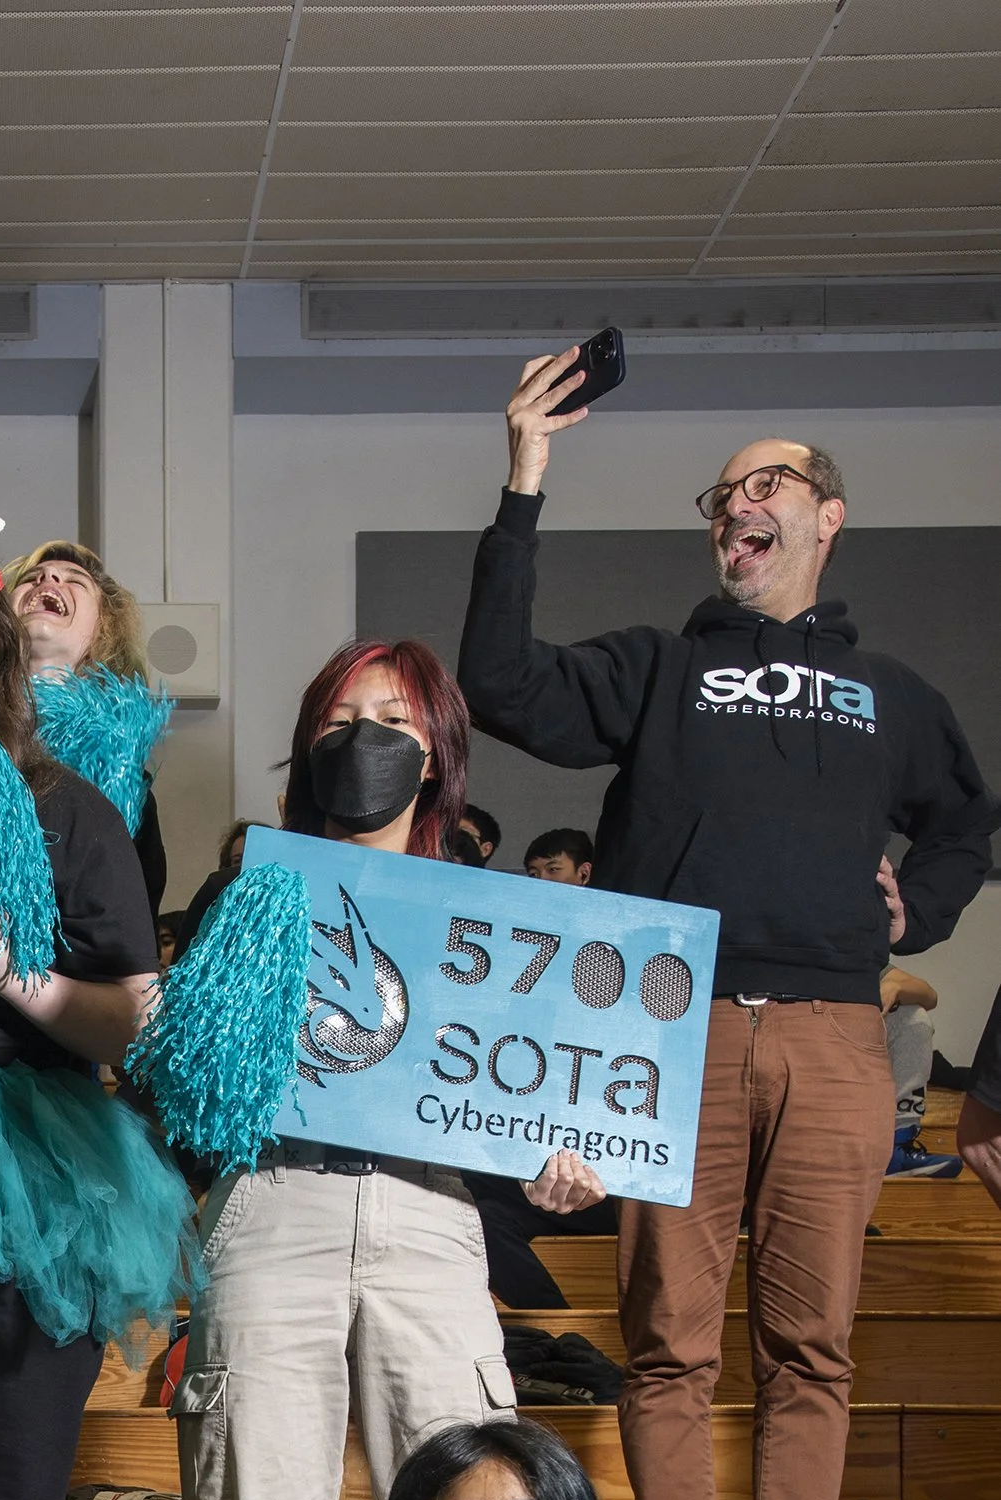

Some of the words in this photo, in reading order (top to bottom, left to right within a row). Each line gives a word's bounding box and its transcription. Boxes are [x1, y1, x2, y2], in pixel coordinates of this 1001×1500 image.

[696, 701, 876, 734] CYBERDRAGONS
[699, 662, 876, 721] SOTa
[438, 916, 694, 1022] 5700
[429, 1023, 660, 1120] SOTa
[415, 1094, 670, 1167] Cyberdragons
